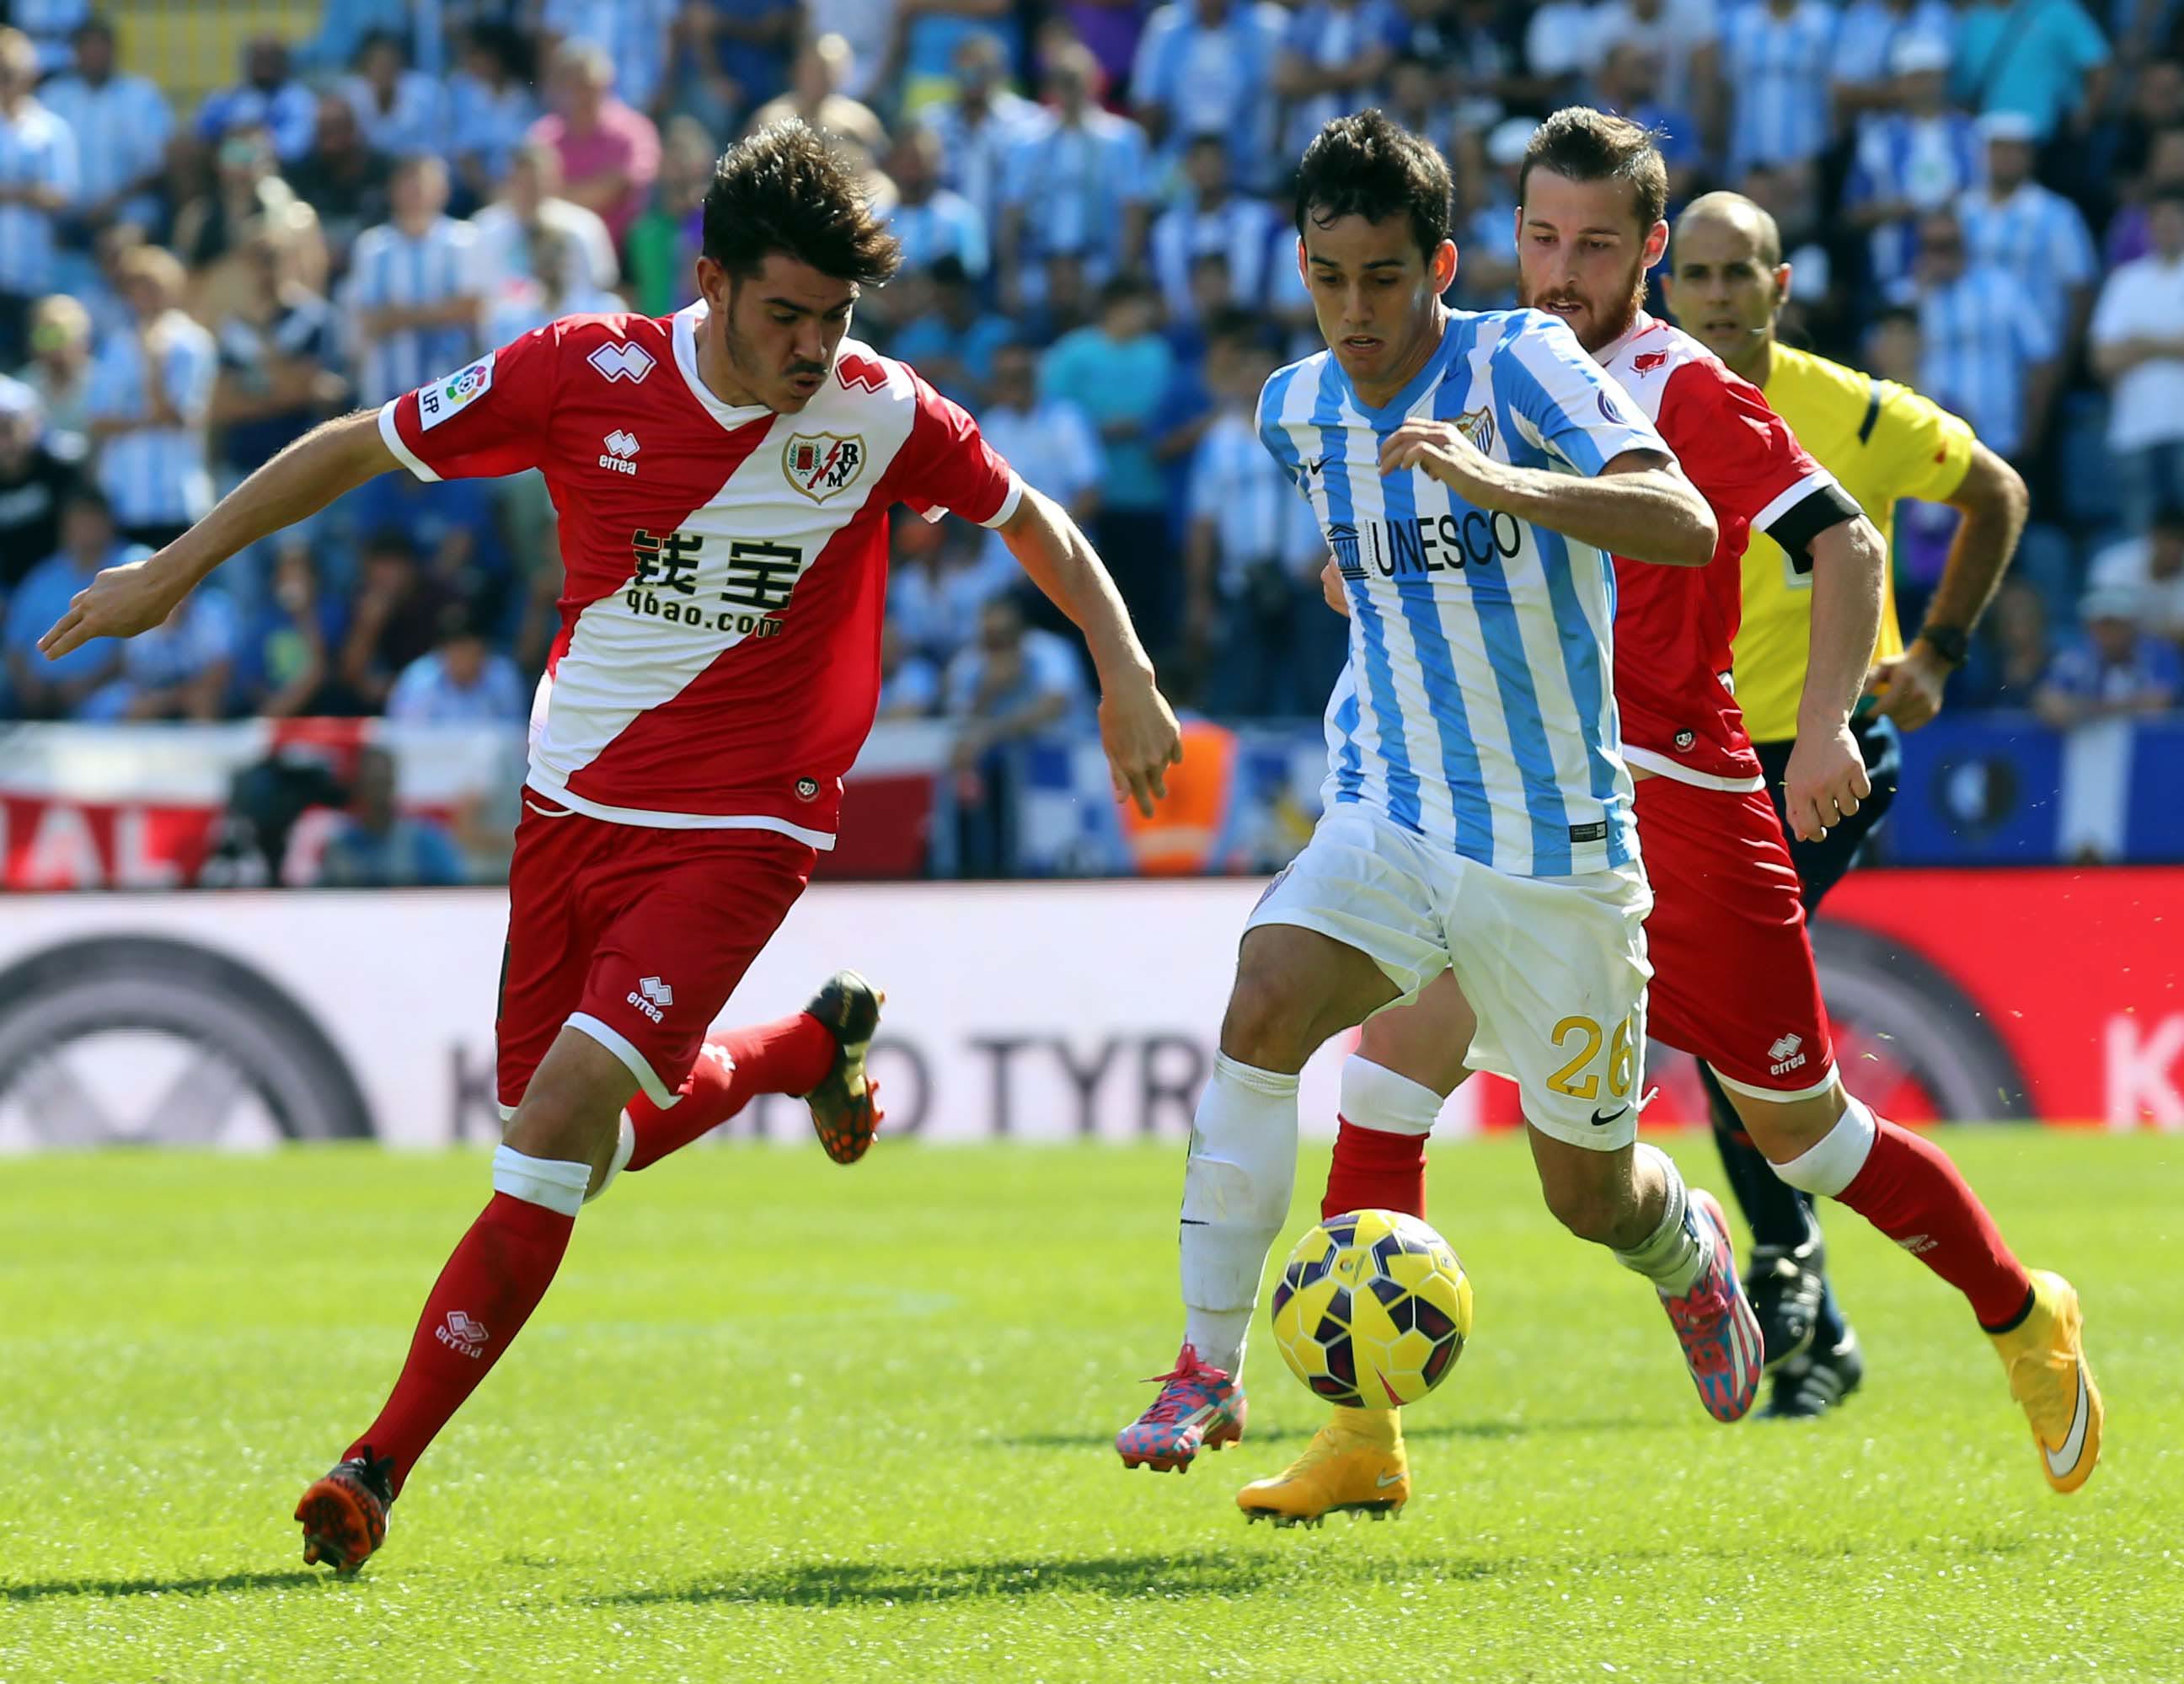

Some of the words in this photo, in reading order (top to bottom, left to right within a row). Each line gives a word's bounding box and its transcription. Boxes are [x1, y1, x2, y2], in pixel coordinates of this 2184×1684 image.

[422, 389, 440, 414] LFP
[598, 453, 637, 476] errea
[1372, 511, 1522, 577] UNESCO
[626, 588, 784, 637] qbao.com
[626, 991, 665, 1025] errea
[1546, 1015, 1634, 1101] 26
[1769, 1052, 1807, 1075] errea
[964, 1033, 1207, 1134] TYR
[435, 1324, 483, 1360] errea
